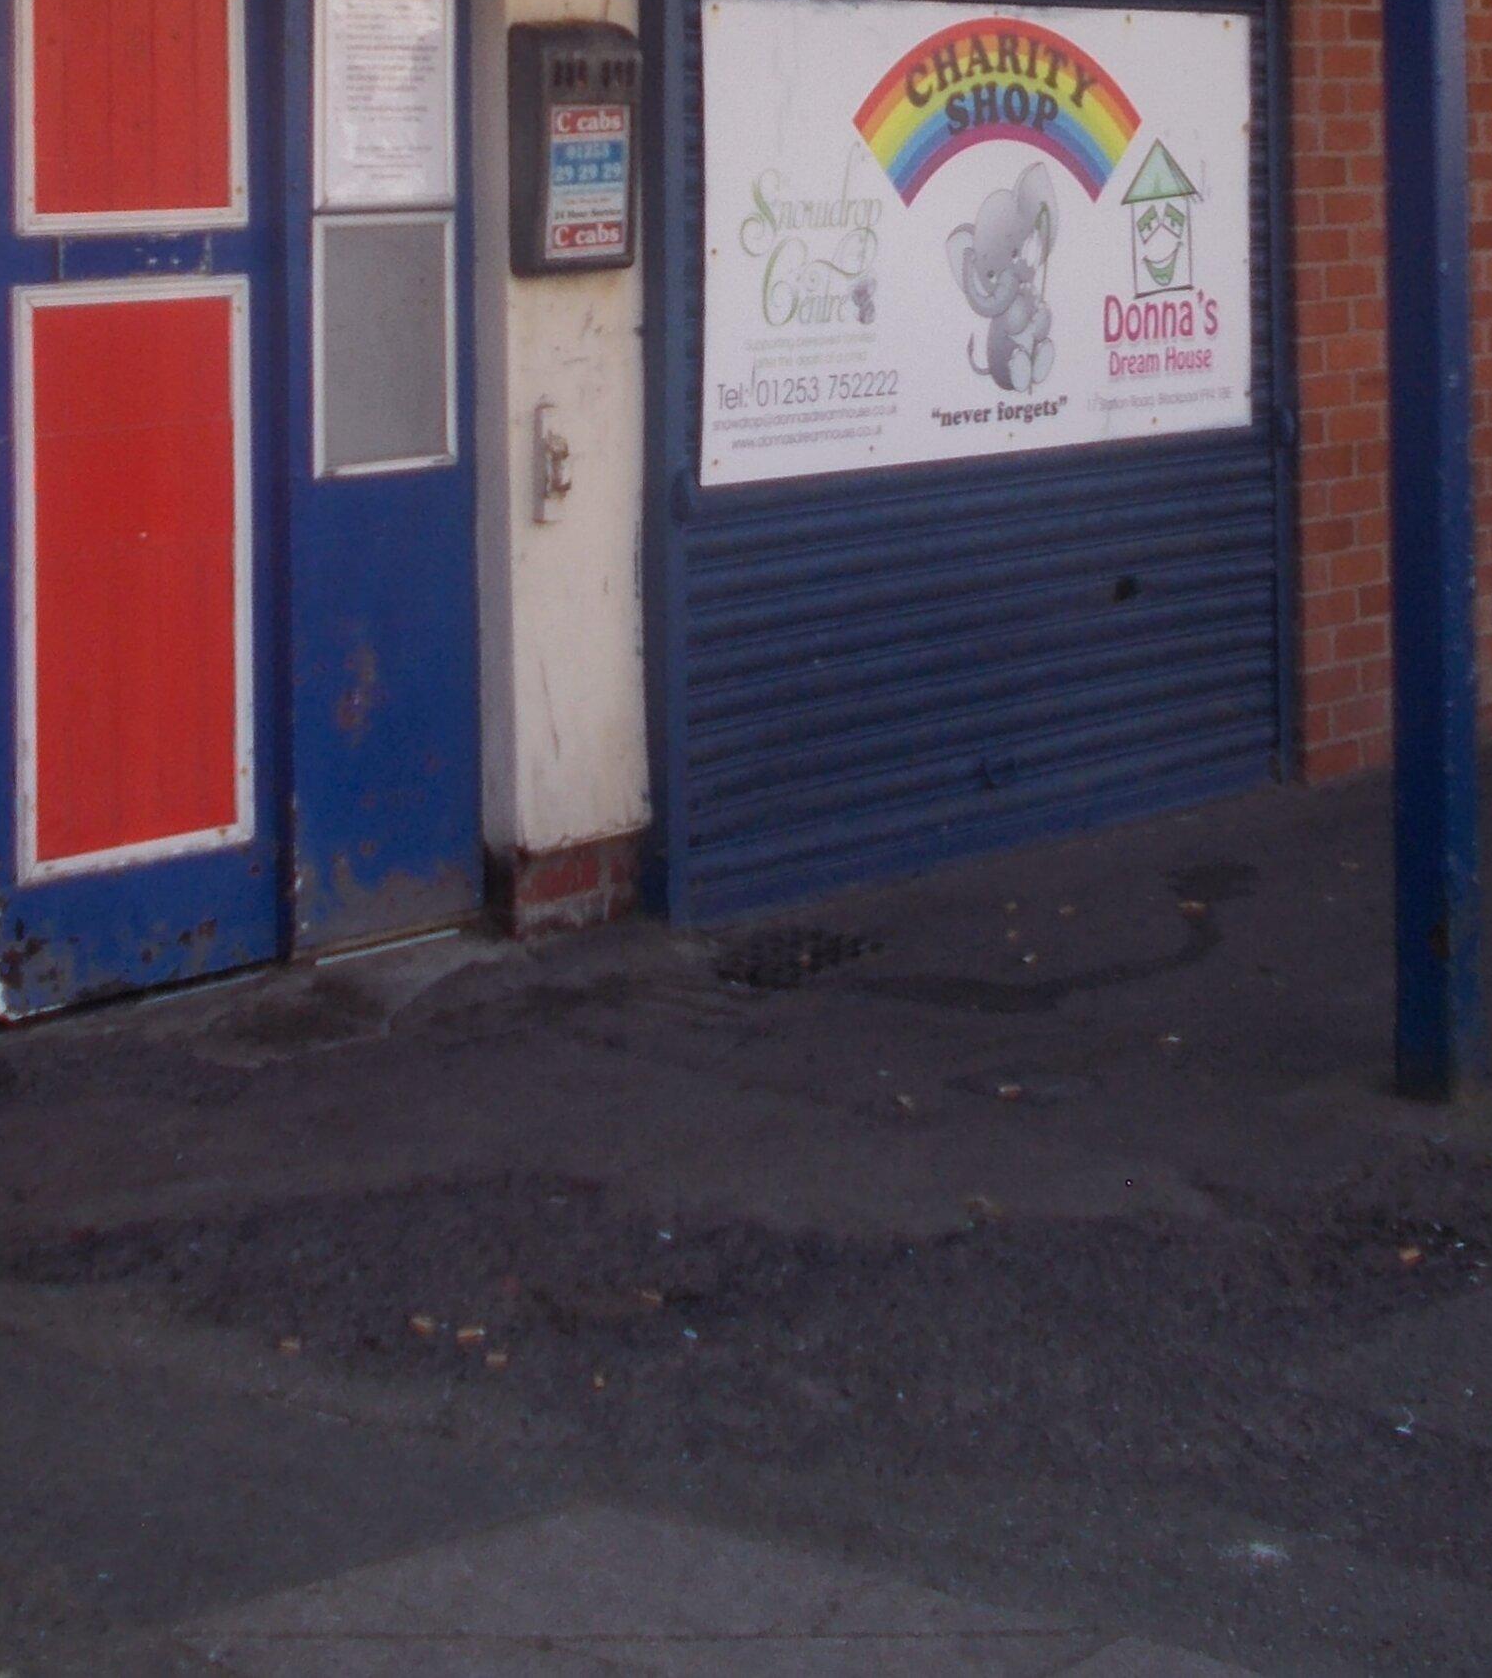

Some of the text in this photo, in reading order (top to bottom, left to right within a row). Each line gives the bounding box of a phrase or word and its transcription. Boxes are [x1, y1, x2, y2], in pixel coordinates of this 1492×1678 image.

[903, 30, 1099, 112] CHARITY
[557, 109, 623, 133] C cabs
[944, 79, 1060, 137] SHOP
[554, 223, 621, 246] C cabs
[1104, 289, 1218, 343] Donna's
[1109, 347, 1212, 376] Dream House
[717, 369, 899, 410] Tel: 01253 752222
